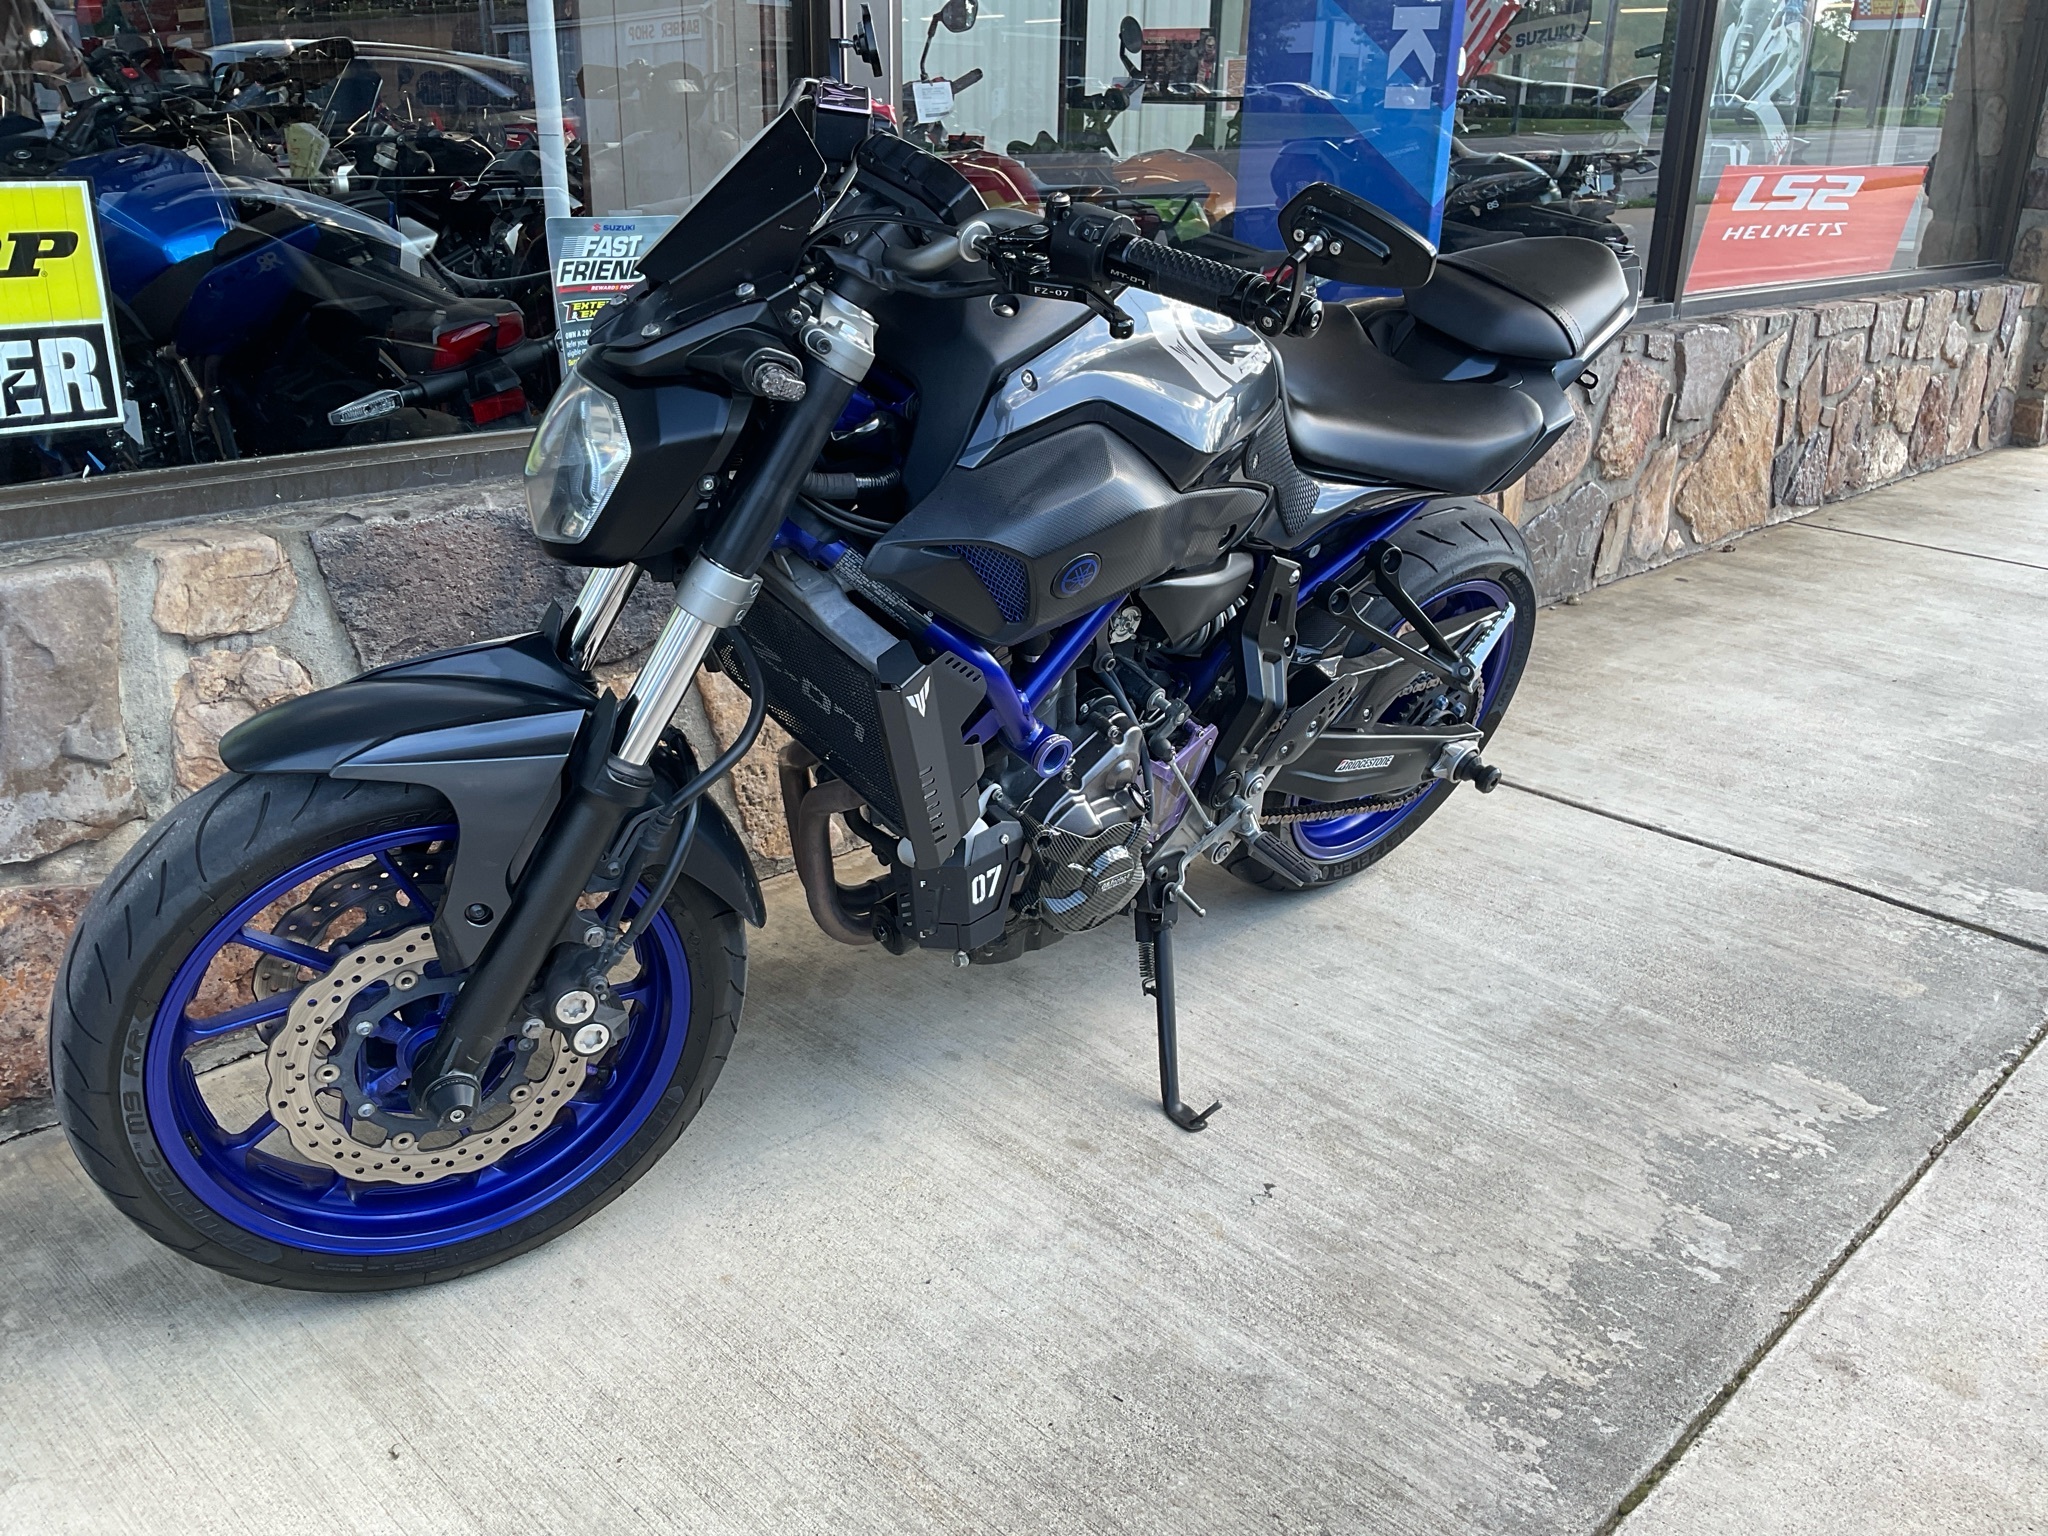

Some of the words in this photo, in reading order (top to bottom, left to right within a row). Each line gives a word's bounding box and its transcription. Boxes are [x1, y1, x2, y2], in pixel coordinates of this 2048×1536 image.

[1515, 23, 1577, 47] SUZUKI
[1731, 174, 1865, 212] LS2
[603, 224, 636, 232] SUZUKI
[1722, 222, 1848, 241] HELMETS
[581, 235, 643, 257] FAST
[1109, 268, 1146, 287] MT-07
[1034, 286, 1070, 297] FZ-07
[1336, 756, 1393, 772] BRIDGESTONE
[971, 863, 1003, 905] 07
